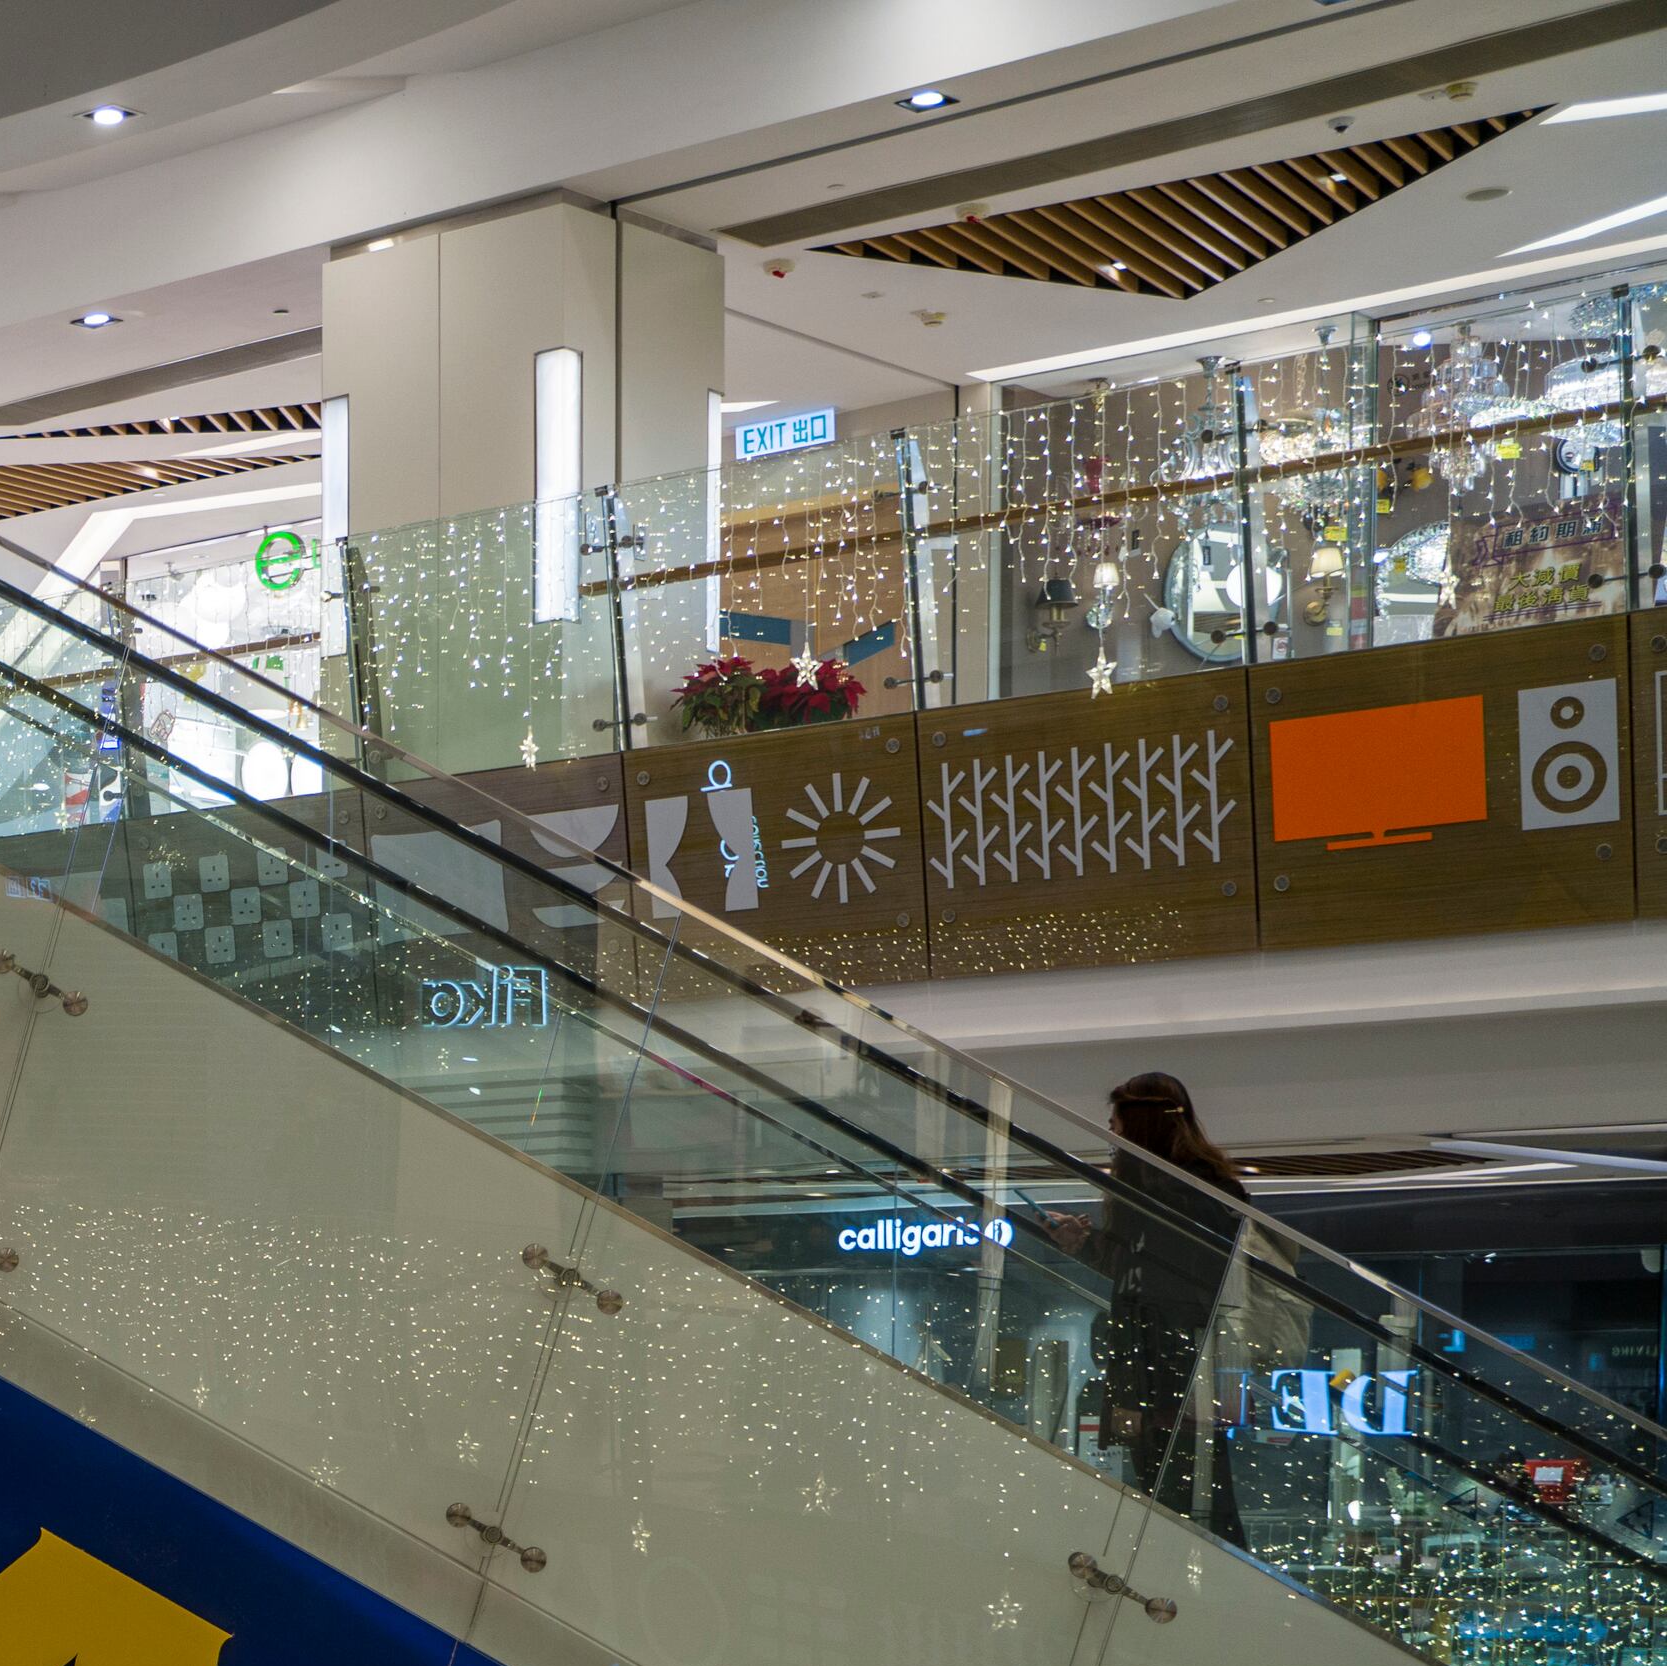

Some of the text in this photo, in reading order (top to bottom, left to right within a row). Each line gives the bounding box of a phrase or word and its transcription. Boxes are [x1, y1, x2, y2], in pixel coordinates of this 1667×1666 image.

[743, 414, 827, 455] EXIT 出口
[1508, 562, 1582, 593] 大減價
